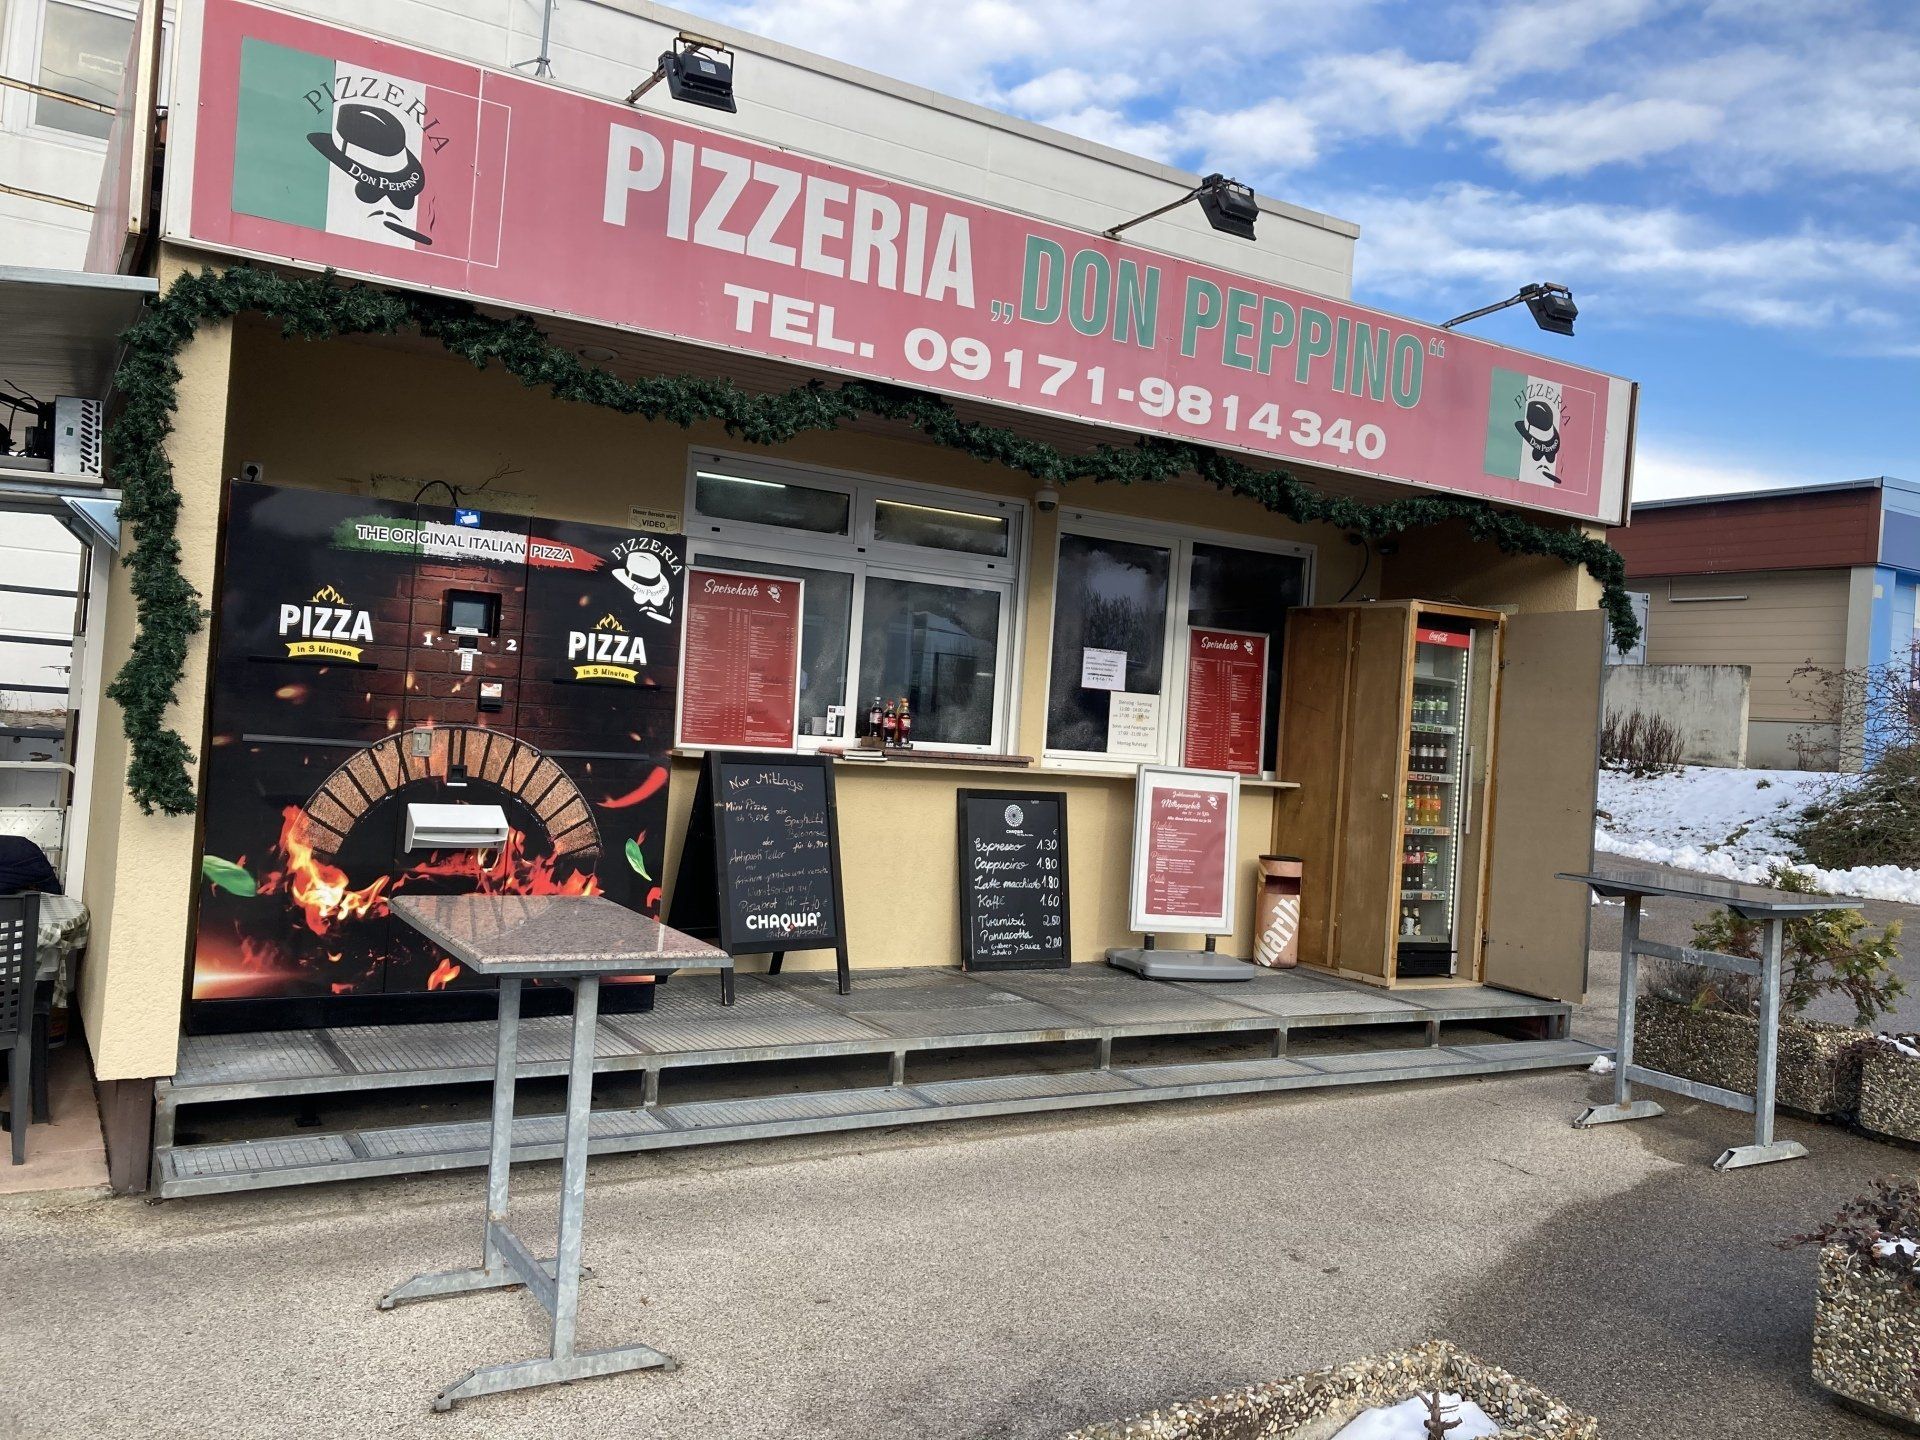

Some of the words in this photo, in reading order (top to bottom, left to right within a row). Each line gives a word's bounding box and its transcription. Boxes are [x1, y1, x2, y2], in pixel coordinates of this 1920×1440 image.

[303, 76, 449, 154] PIZZERIA
[603, 123, 975, 308] PIZZERIA
[724, 283, 874, 358] TEL.
[904, 328, 1386, 459] 09171-9814340
[1514, 384, 1571, 426] PIZZERIA
[641, 519, 666, 528] VIDEO
[356, 524, 389, 541] THE
[390, 528, 465, 549] ORIGINAL
[468, 537, 526, 555] ITALIAN
[531, 545, 574, 562] PIZZA
[611, 538, 683, 576] PIZZERIA
[704, 578, 760, 598] Speisekarte
[279, 603, 374, 642] PIZZA
[423, 634, 434, 647] 1
[505, 639, 518, 652] 2
[568, 631, 647, 665] PIZZA
[1201, 636, 1239, 651] Speisekarte
[308, 645, 315, 653] 3
[318, 645, 352, 656] Minuten
[601, 668, 629, 678] Minuten
[729, 776, 750, 790] Nur
[974, 838, 1026, 857] Espresso
[1036, 839, 1058, 850] 1.30
[1036, 857, 1058, 870] 1.80
[1041, 875, 1059, 890] 1.80
[1039, 895, 1060, 907] 1.60
